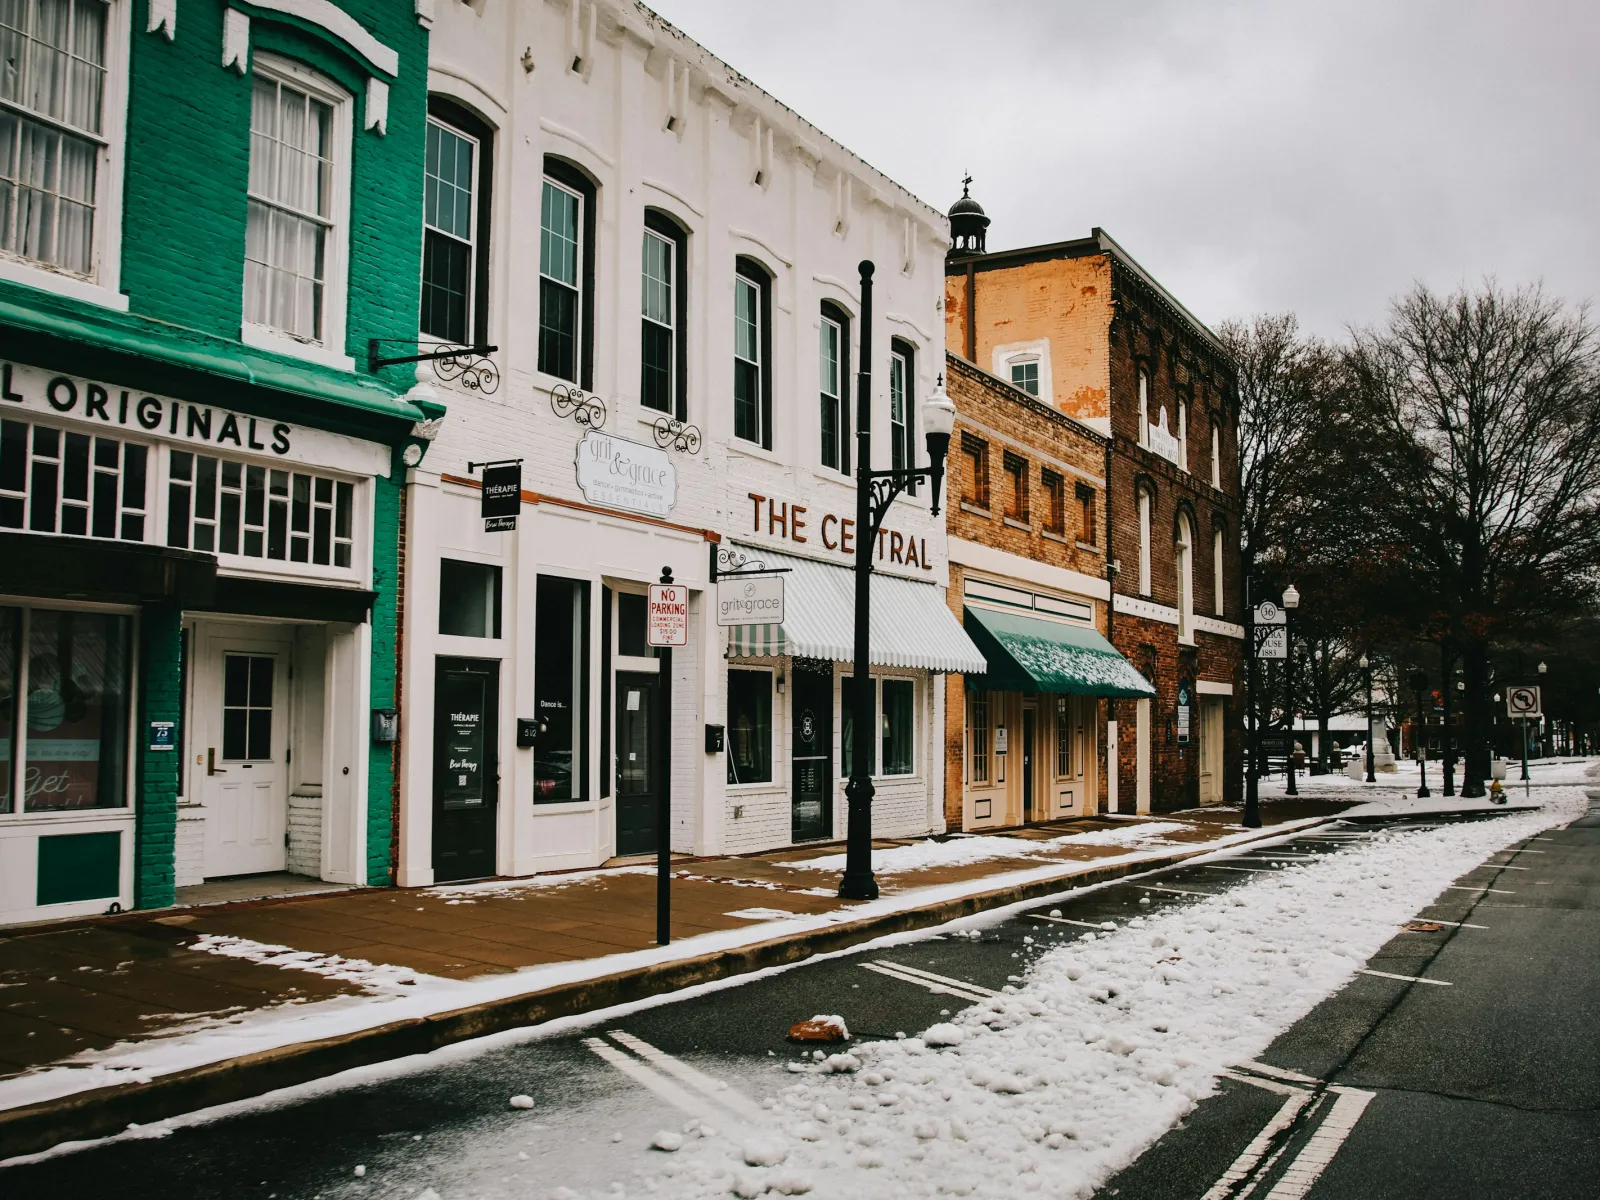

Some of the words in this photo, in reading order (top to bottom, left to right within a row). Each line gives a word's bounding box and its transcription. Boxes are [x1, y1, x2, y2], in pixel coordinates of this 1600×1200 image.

[47, 376, 291, 455] ORIGINALS
[590, 438, 614, 463] grit
[609, 452, 631, 476] &
[629, 463, 666, 488] grace
[485, 484, 518, 495] THÉRAPIE
[614, 484, 644, 497] gymnastics
[748, 492, 807, 543] THE
[822, 514, 932, 570] CETRAL
[661, 590, 676, 602] NO
[651, 603, 685, 615] PARKING
[1263, 606, 1274, 617] 36
[1262, 640, 1283, 648] OUSE
[1261, 649, 1277, 657] 1883
[540, 700, 557, 708] Dance
[450, 711, 480, 722] THÉRAPIE
[716, 740, 721, 748] 7
